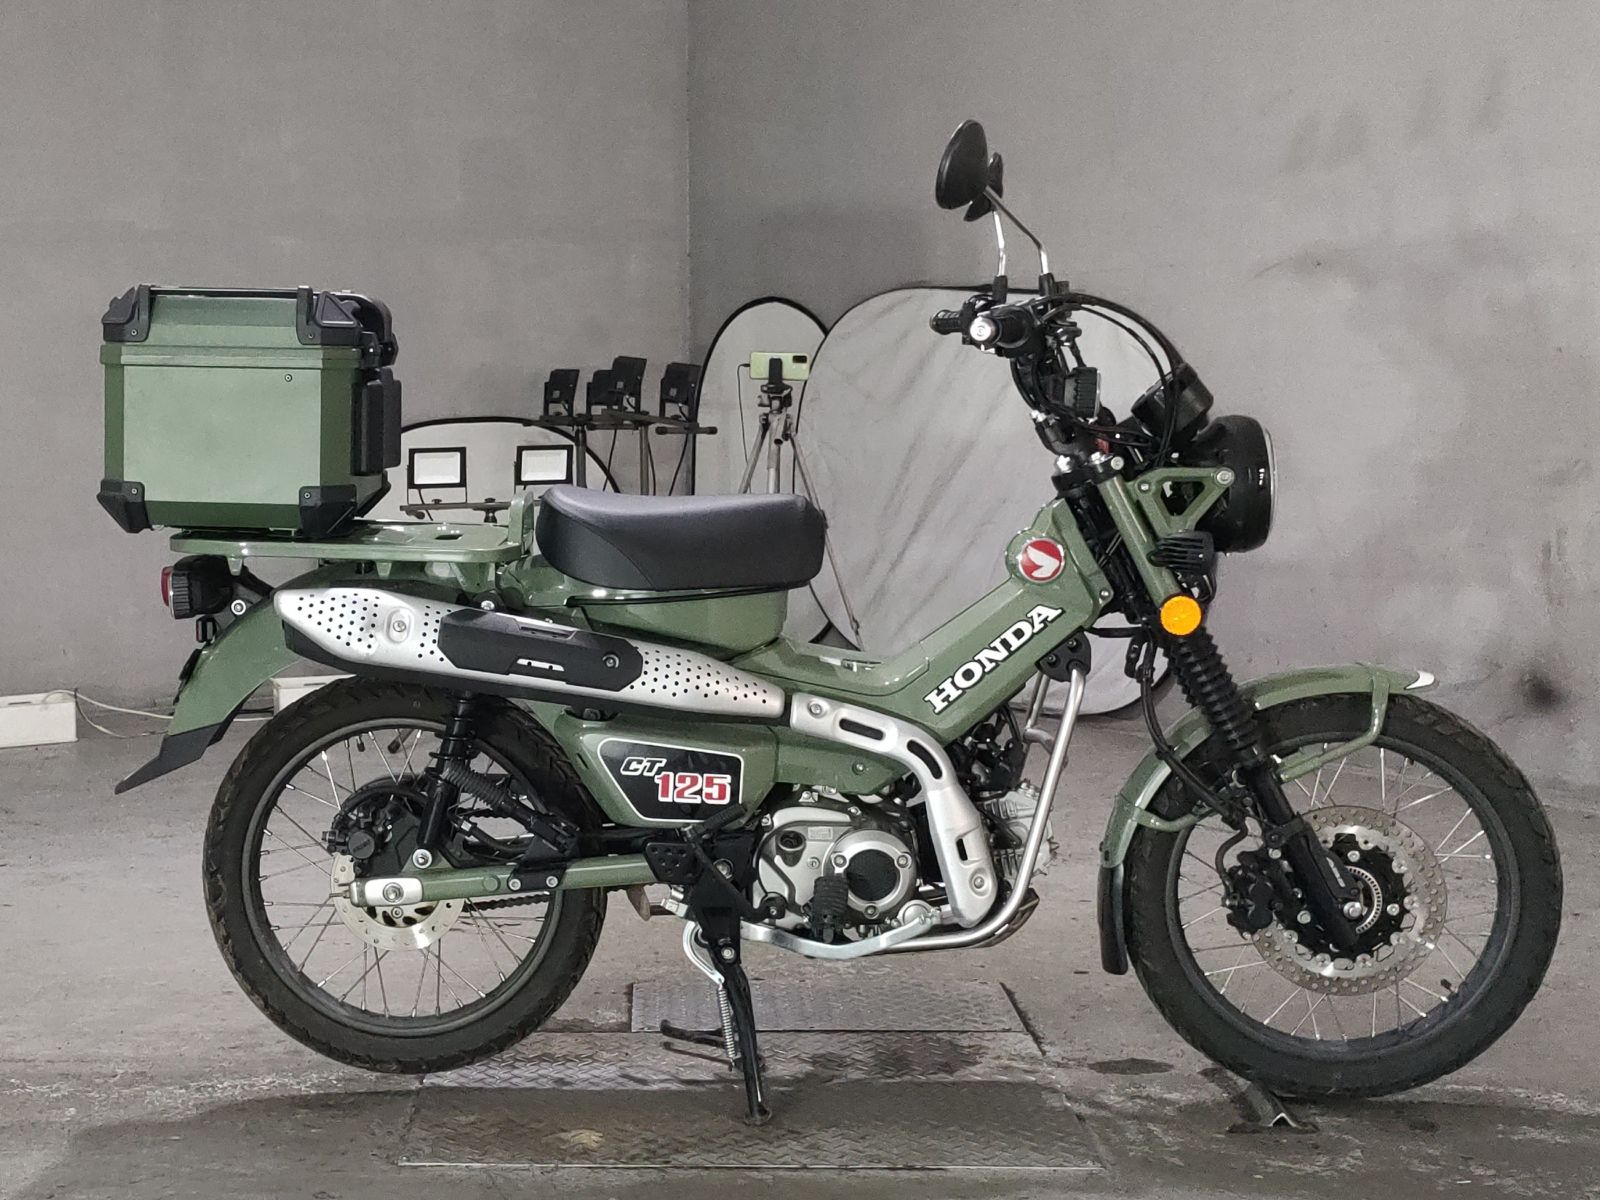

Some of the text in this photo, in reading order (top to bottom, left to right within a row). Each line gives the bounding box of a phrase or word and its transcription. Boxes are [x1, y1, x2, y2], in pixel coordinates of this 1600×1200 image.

[923, 604, 1064, 714] HONDA
[620, 756, 667, 776] CT
[654, 771, 731, 804] 125
